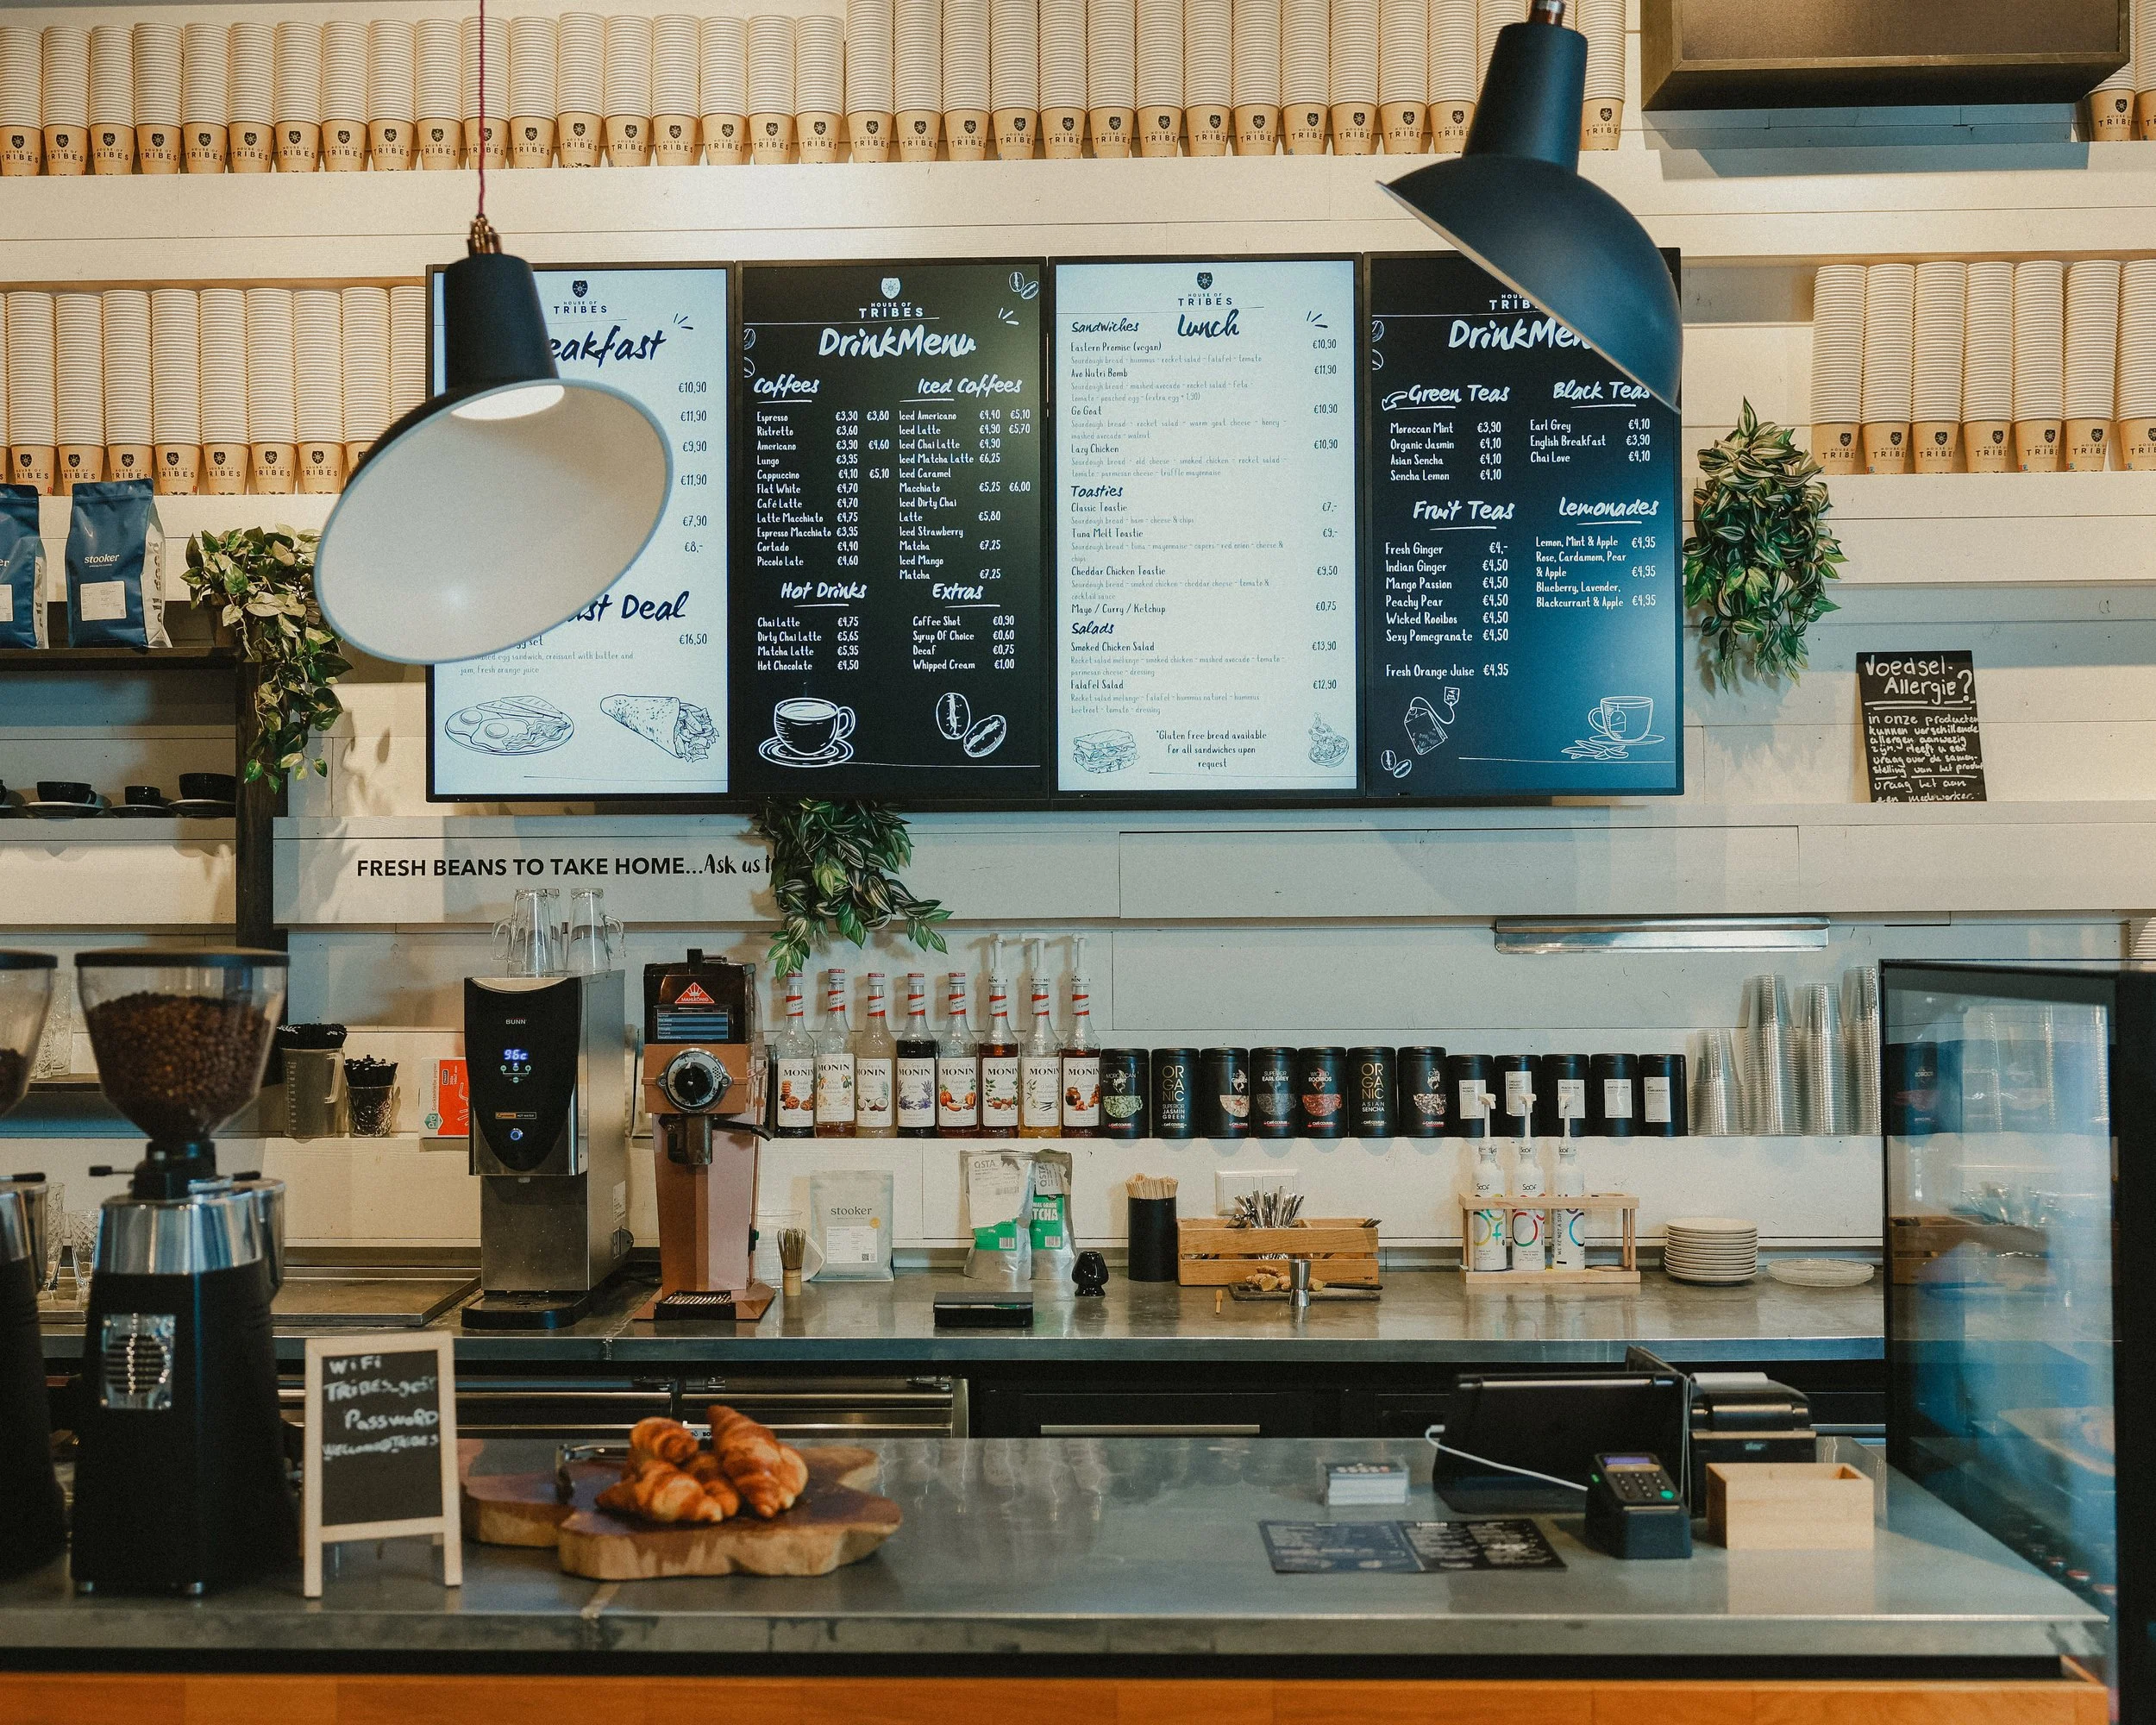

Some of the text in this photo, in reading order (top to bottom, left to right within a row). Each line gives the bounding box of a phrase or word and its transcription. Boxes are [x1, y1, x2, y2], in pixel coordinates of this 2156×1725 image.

[561, 141, 598, 152] TRIBES
[1178, 298, 1232, 306] TRIBES
[1489, 300, 1532, 311] TRIB
[554, 305, 607, 314] TRIBES
[859, 307, 923, 318] TRIBES
[1071, 317, 1139, 333] Sandwiches
[1177, 309, 1239, 338] Lunch
[549, 324, 667, 368] eakfast
[818, 323, 977, 359] DrinkMenu
[1071, 342, 1162, 353] Eastern Promise (vegan)
[679, 381, 706, 393] €10,90
[753, 373, 820, 398] Coffees
[918, 373, 1023, 398] Iced Coffees
[1553, 379, 1651, 400] Black Teas
[1408, 385, 1510, 404] Green Teas
[757, 411, 858, 424] Espresso €3,30
[757, 426, 858, 436] Ristretto €3,60
[1390, 422, 1453, 434] Moroccan Mint
[1477, 421, 1501, 433] €3,90
[683, 441, 706, 453] €9,90
[1531, 435, 1606, 448] English Breakfast
[899, 453, 1000, 464] Iced Matcha Latte €6,25
[757, 469, 799, 482] Cappuccino
[1070, 485, 1123, 498] Toasties
[1071, 502, 1127, 512] Classic Toastie
[1413, 500, 1515, 521] Fruit Teas
[1559, 497, 1659, 517] Lemonades
[683, 515, 707, 527] €7,90
[899, 527, 963, 538] Iced Strawberry
[899, 540, 1000, 551] Matcha €7,25
[84, 553, 120, 564] stooker
[781, 581, 867, 599] Hot Drinks
[1386, 577, 1452, 591] Mango Passion
[932, 582, 983, 600] Extras
[620, 591, 690, 622] Deal
[1316, 601, 1336, 612] €0,75
[1386, 612, 1457, 624] Wicked Rooibos
[1072, 621, 1114, 635] Salads
[680, 633, 707, 645] €16,50
[758, 631, 859, 644] Dirty Chai Latte €5,65
[1386, 630, 1472, 643] Sexy Pomegranate
[913, 644, 1014, 656] Decaf €0,75
[1071, 642, 1154, 651] Smoked Chicken Salad
[913, 659, 1014, 672] Whipped Cream €1,00
[1386, 664, 1411, 676] Fresh
[1413, 664, 1447, 678] Orange
[1483, 663, 1508, 677] €4,95
[1865, 655, 1953, 676] Voedsel-
[1868, 712, 1979, 726] in onze producten
[1869, 724, 1979, 735] kunnen verschillende
[1870, 735, 1967, 749] allergen aanwezig
[1194, 745, 1236, 754] sandwiches
[1198, 758, 1226, 769] request
[1873, 756, 1906, 768] vraag
[1930, 755, 1941, 763] de
[1939, 763, 1952, 773] het
[1874, 781, 1914, 794] vraag
[1919, 778, 1937, 788] het
[357, 859, 426, 876] FRESH
[434, 858, 507, 876] BEANS
[513, 858, 545, 875] TO
[550, 858, 609, 875] TAKE
[742, 859, 761, 875] us
[818, 1063, 850, 1072] MONIN
[899, 1068, 931, 1076] MONIN
[830, 1207, 872, 1215] stooker
[1032, 1208, 1058, 1221] TCHA
